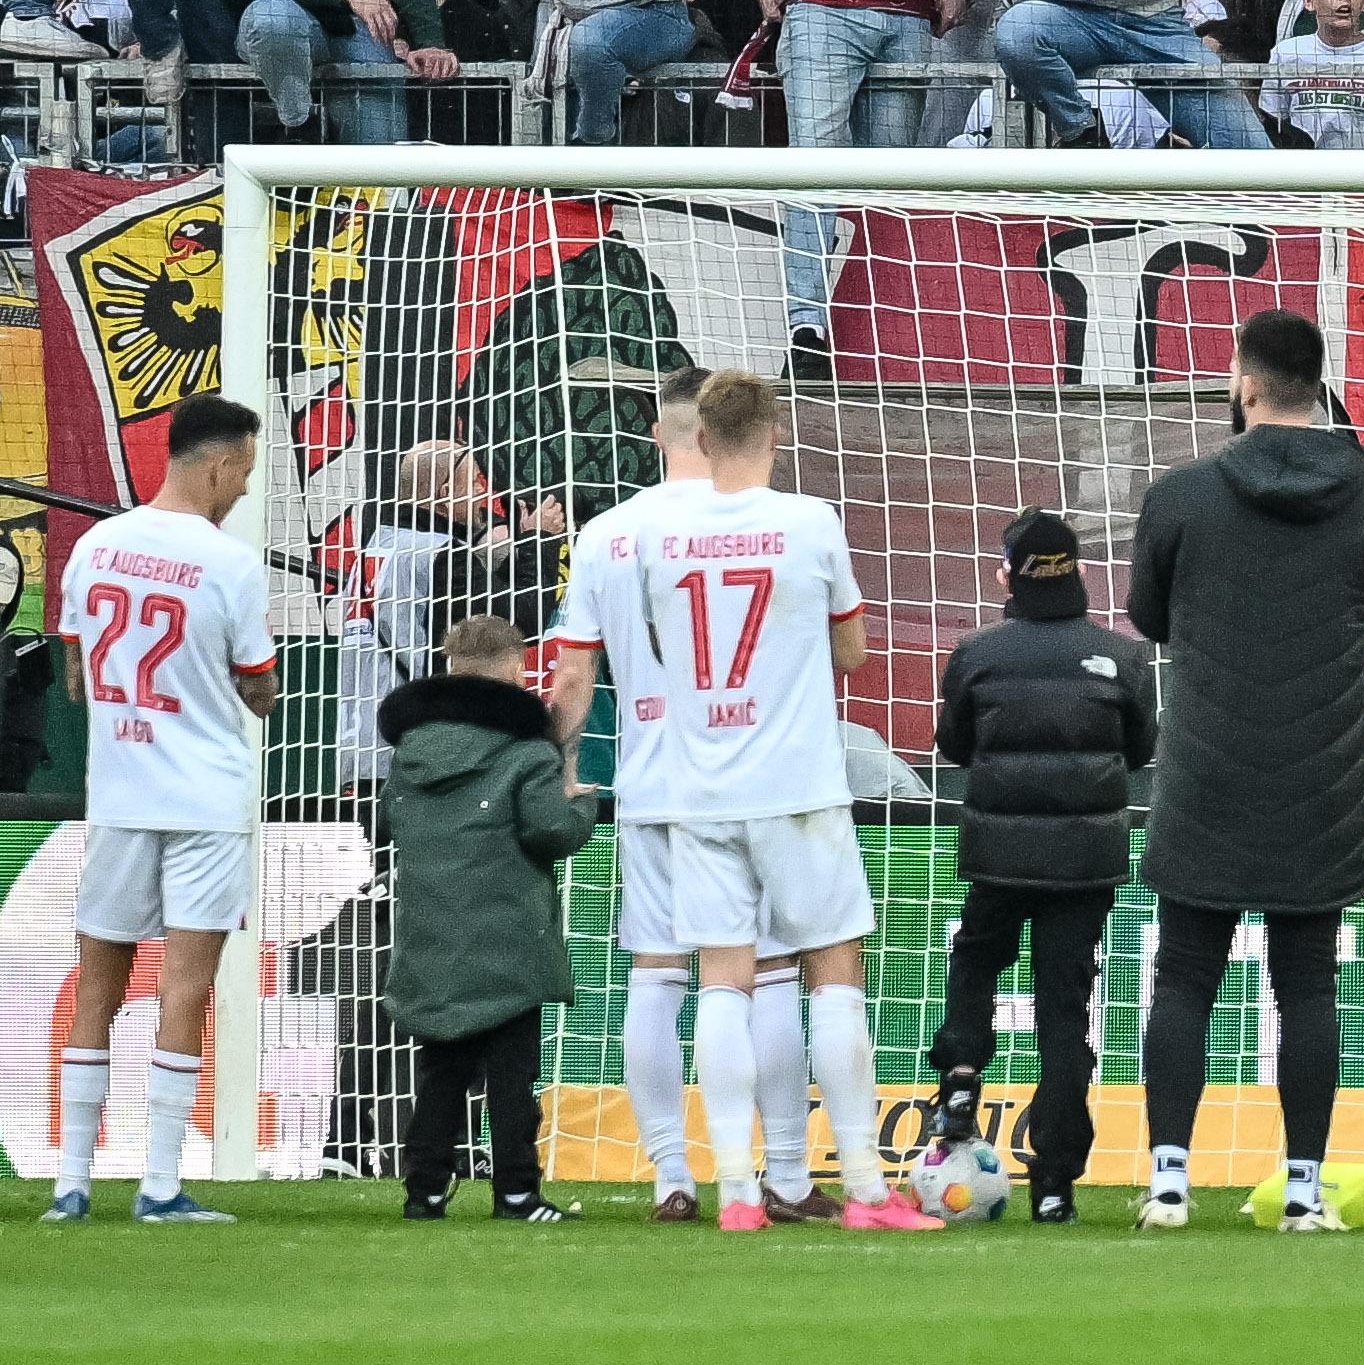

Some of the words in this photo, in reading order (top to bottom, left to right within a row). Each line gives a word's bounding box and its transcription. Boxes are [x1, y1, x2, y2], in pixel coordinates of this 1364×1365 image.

[91, 547, 109, 572] FC
[111, 550, 204, 590] AUGSBURG
[661, 536, 681, 560] FC
[685, 532, 786, 560] AUGSBURG
[87, 581, 189, 714] 22
[675, 568, 775, 691] 17
